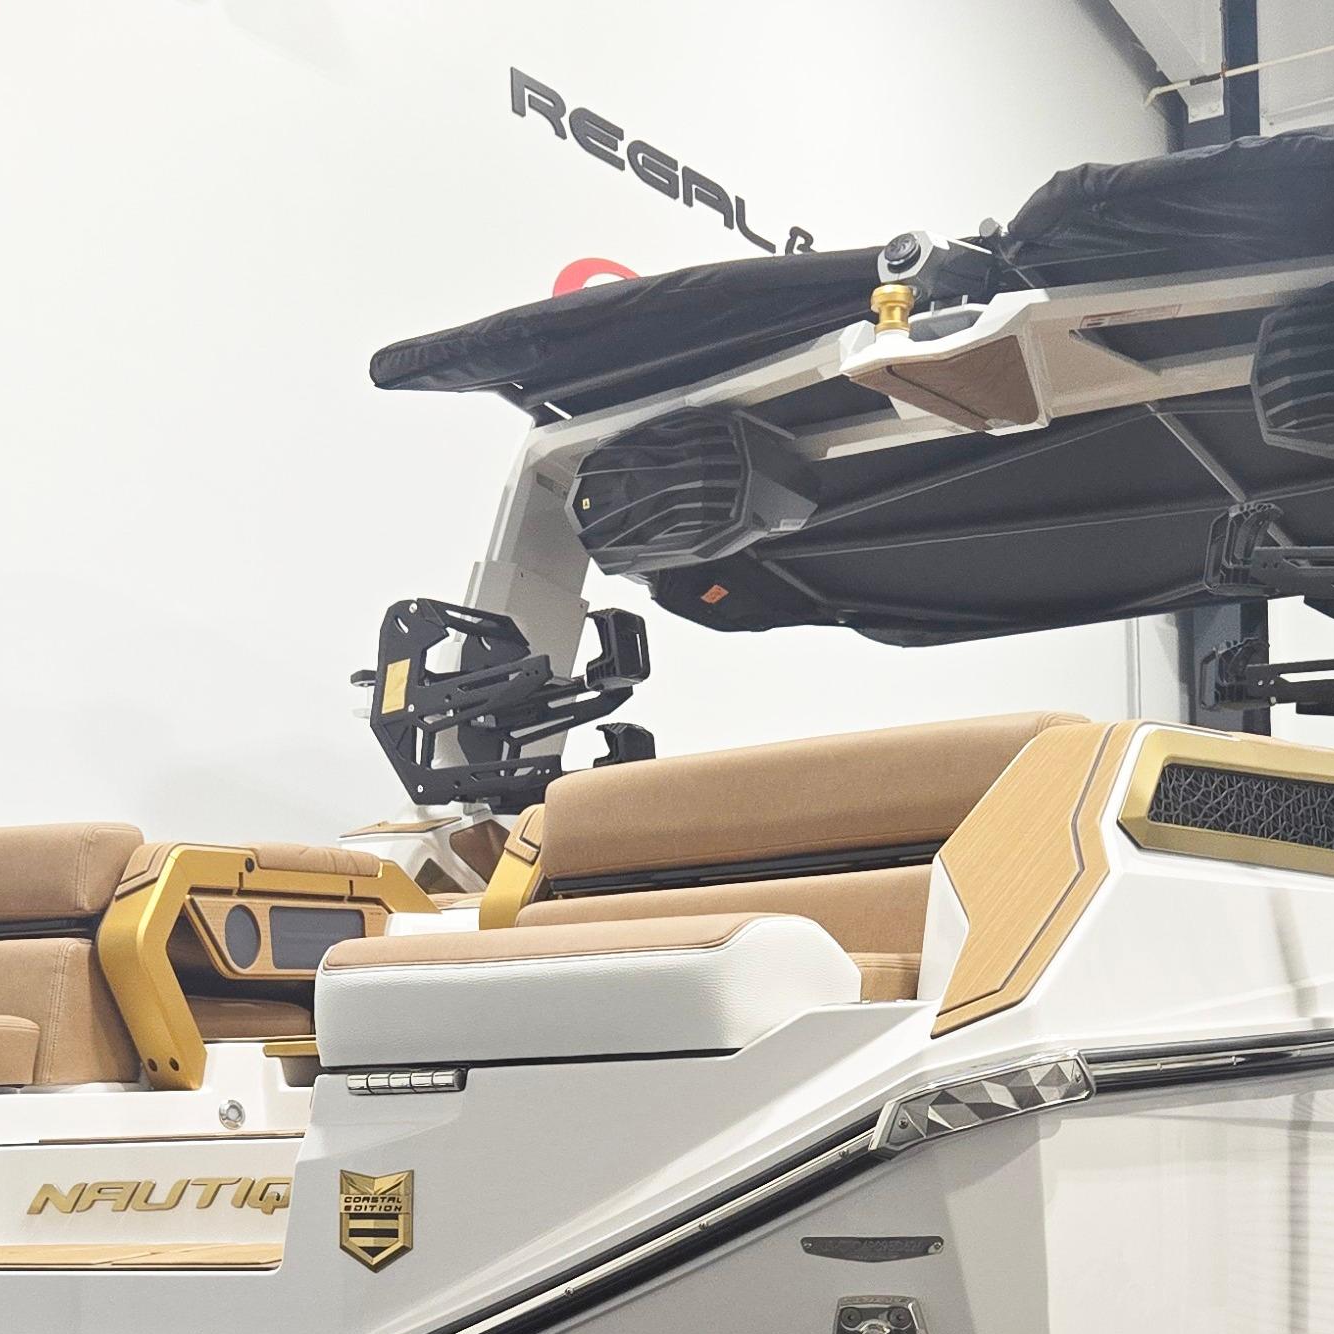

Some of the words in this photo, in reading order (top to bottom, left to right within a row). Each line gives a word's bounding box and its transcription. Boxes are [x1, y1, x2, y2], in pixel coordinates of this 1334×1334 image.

[510, 66, 777, 254] REGAL
[344, 1196, 402, 1204] COASTAL
[344, 1204, 403, 1212] EDITION
